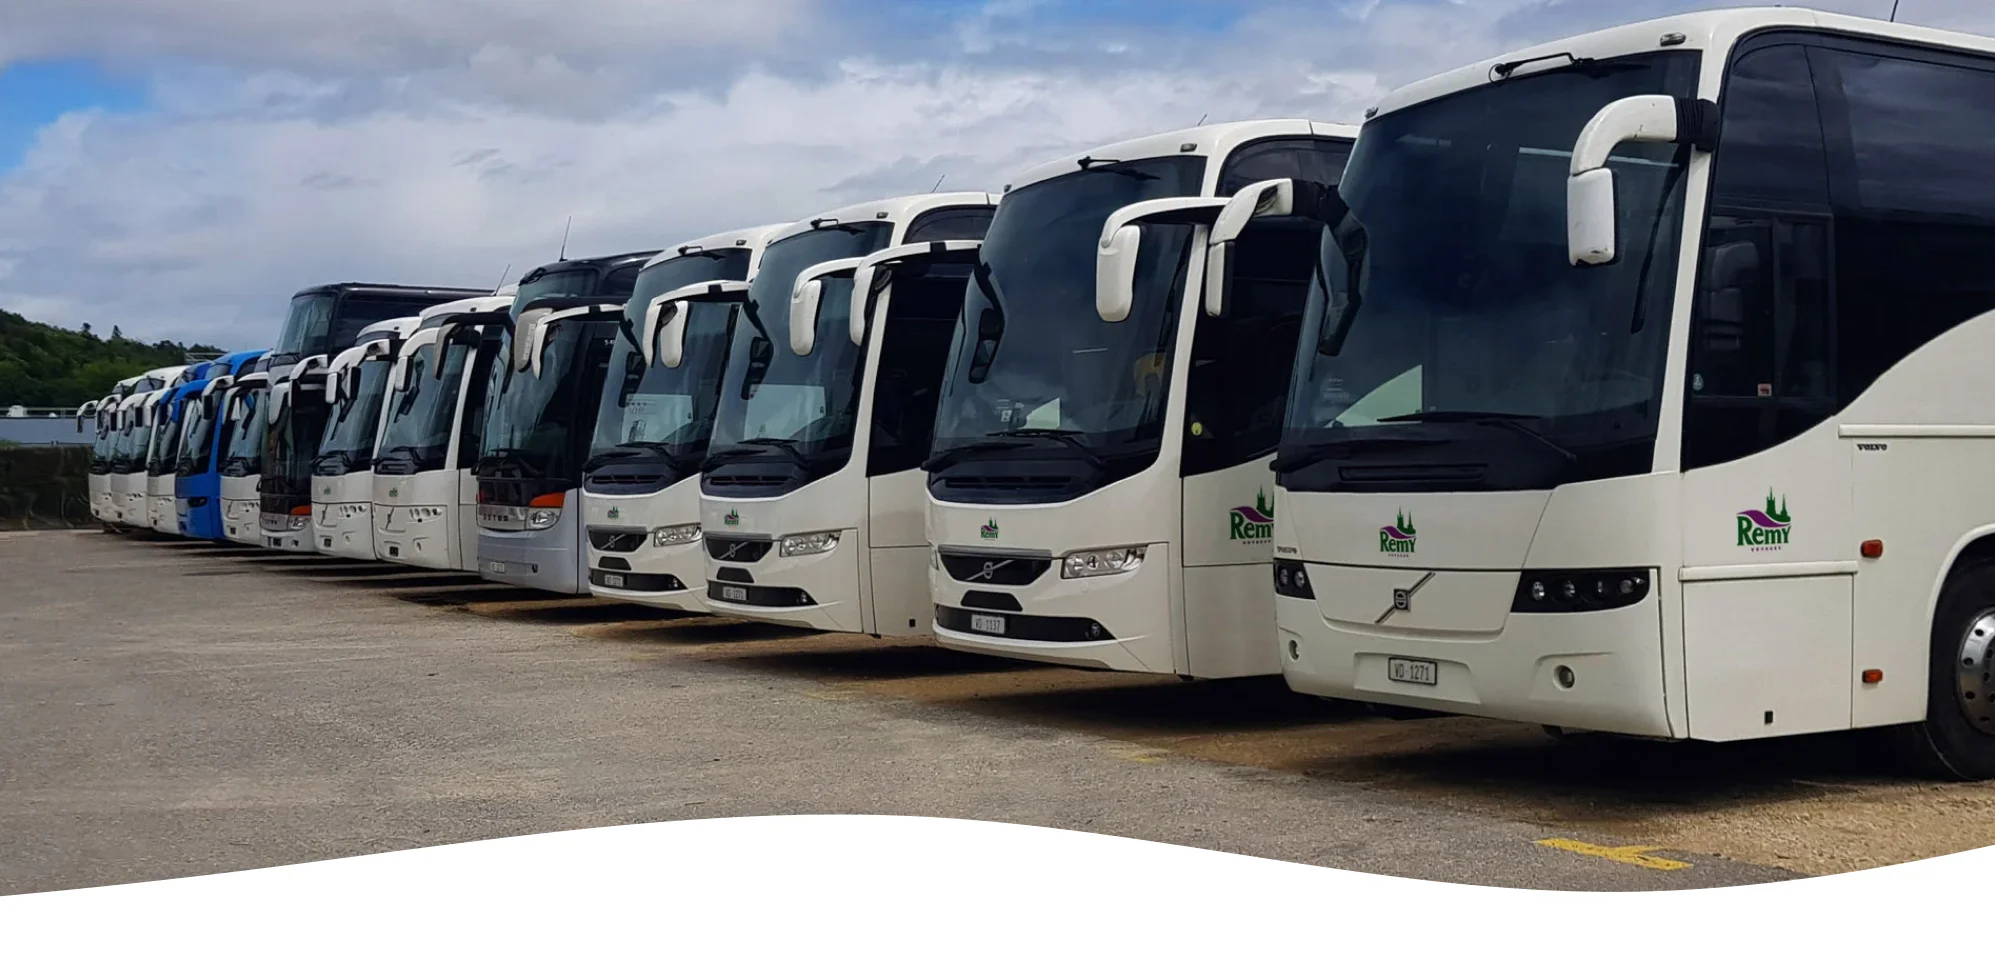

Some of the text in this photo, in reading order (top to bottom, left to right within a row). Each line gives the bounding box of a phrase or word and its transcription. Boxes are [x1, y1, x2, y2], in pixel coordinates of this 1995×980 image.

[1856, 443, 1888, 451] VOLVO
[986, 619, 1001, 631] 1137
[1394, 663, 1430, 681] VD 1271
